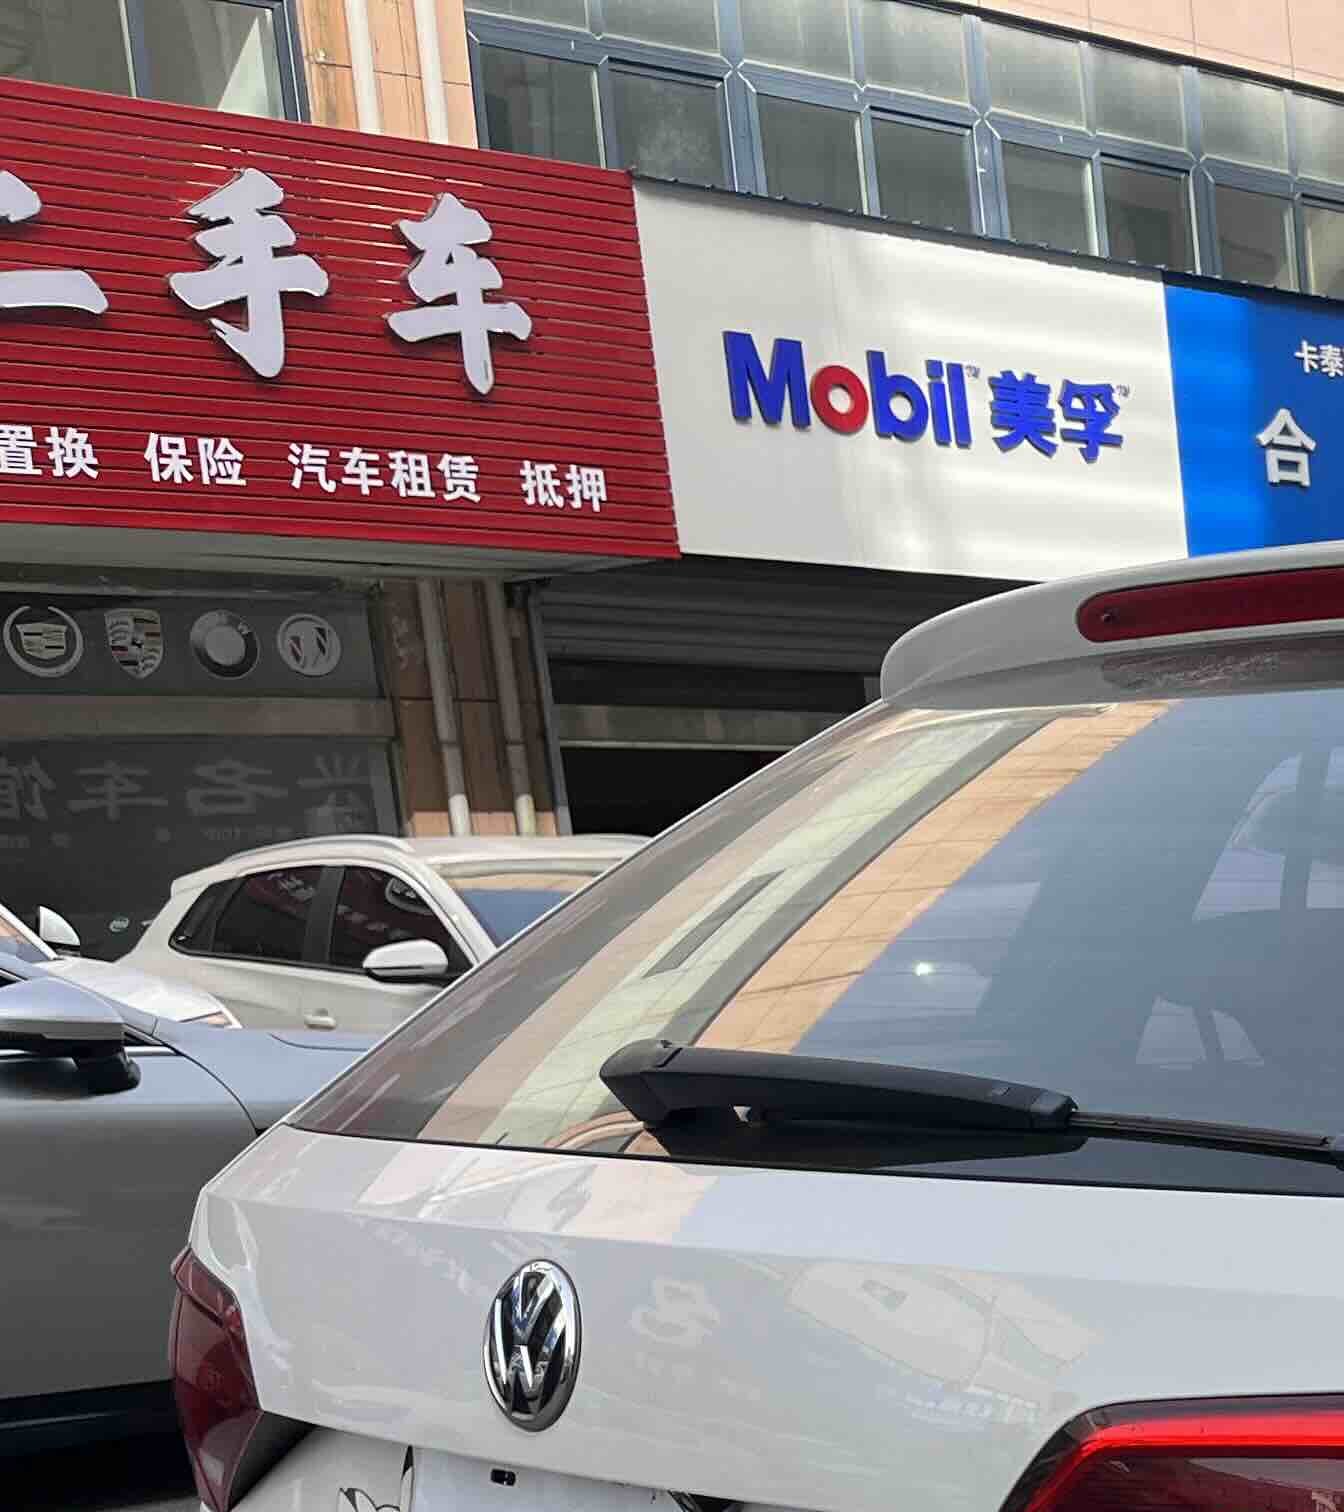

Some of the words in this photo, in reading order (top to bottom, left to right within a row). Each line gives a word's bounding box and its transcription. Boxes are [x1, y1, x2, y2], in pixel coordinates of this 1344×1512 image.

[0, 167, 533, 396] 二手车
[722, 330, 972, 449] Mobil
[987, 369, 1124, 465] 美孚
[0, 424, 99, 479] 置换
[144, 432, 247, 488] 保险
[287, 442, 482, 504] 汽车租赁
[520, 459, 608, 513] 抵押
